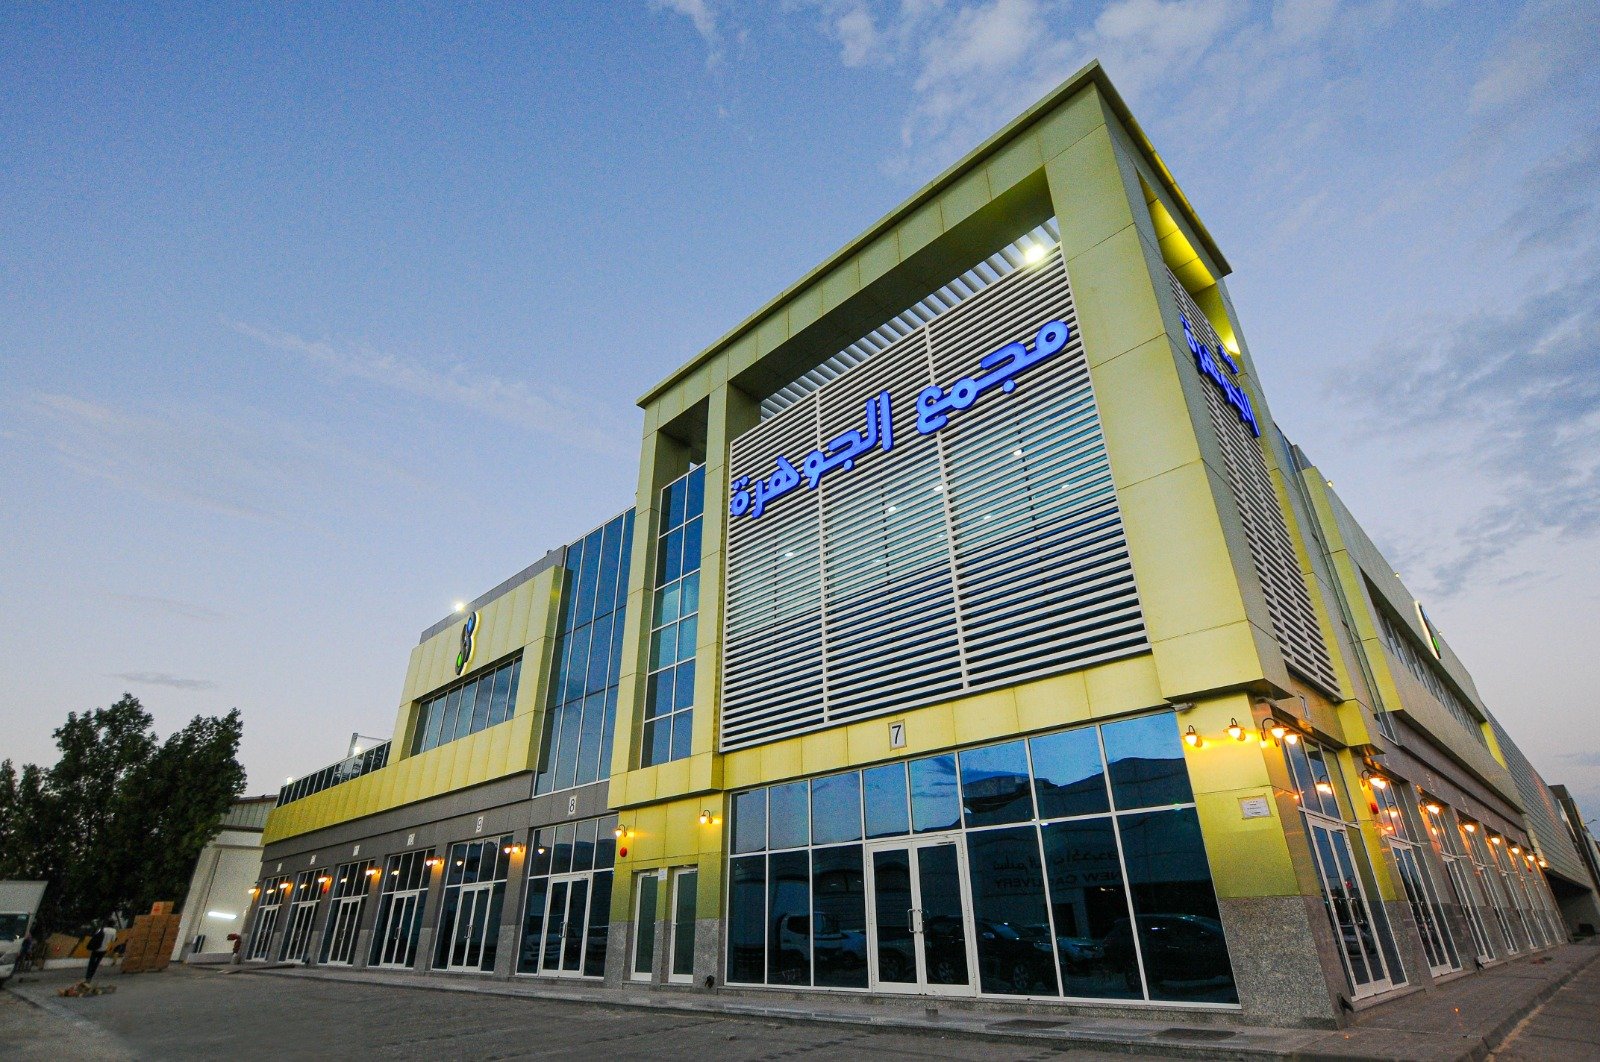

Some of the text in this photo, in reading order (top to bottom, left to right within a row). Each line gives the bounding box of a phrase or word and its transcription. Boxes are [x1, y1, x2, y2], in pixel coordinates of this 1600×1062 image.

[730, 320, 1070, 519] مجمع الجوهرة
[891, 724, 901, 744] 7
